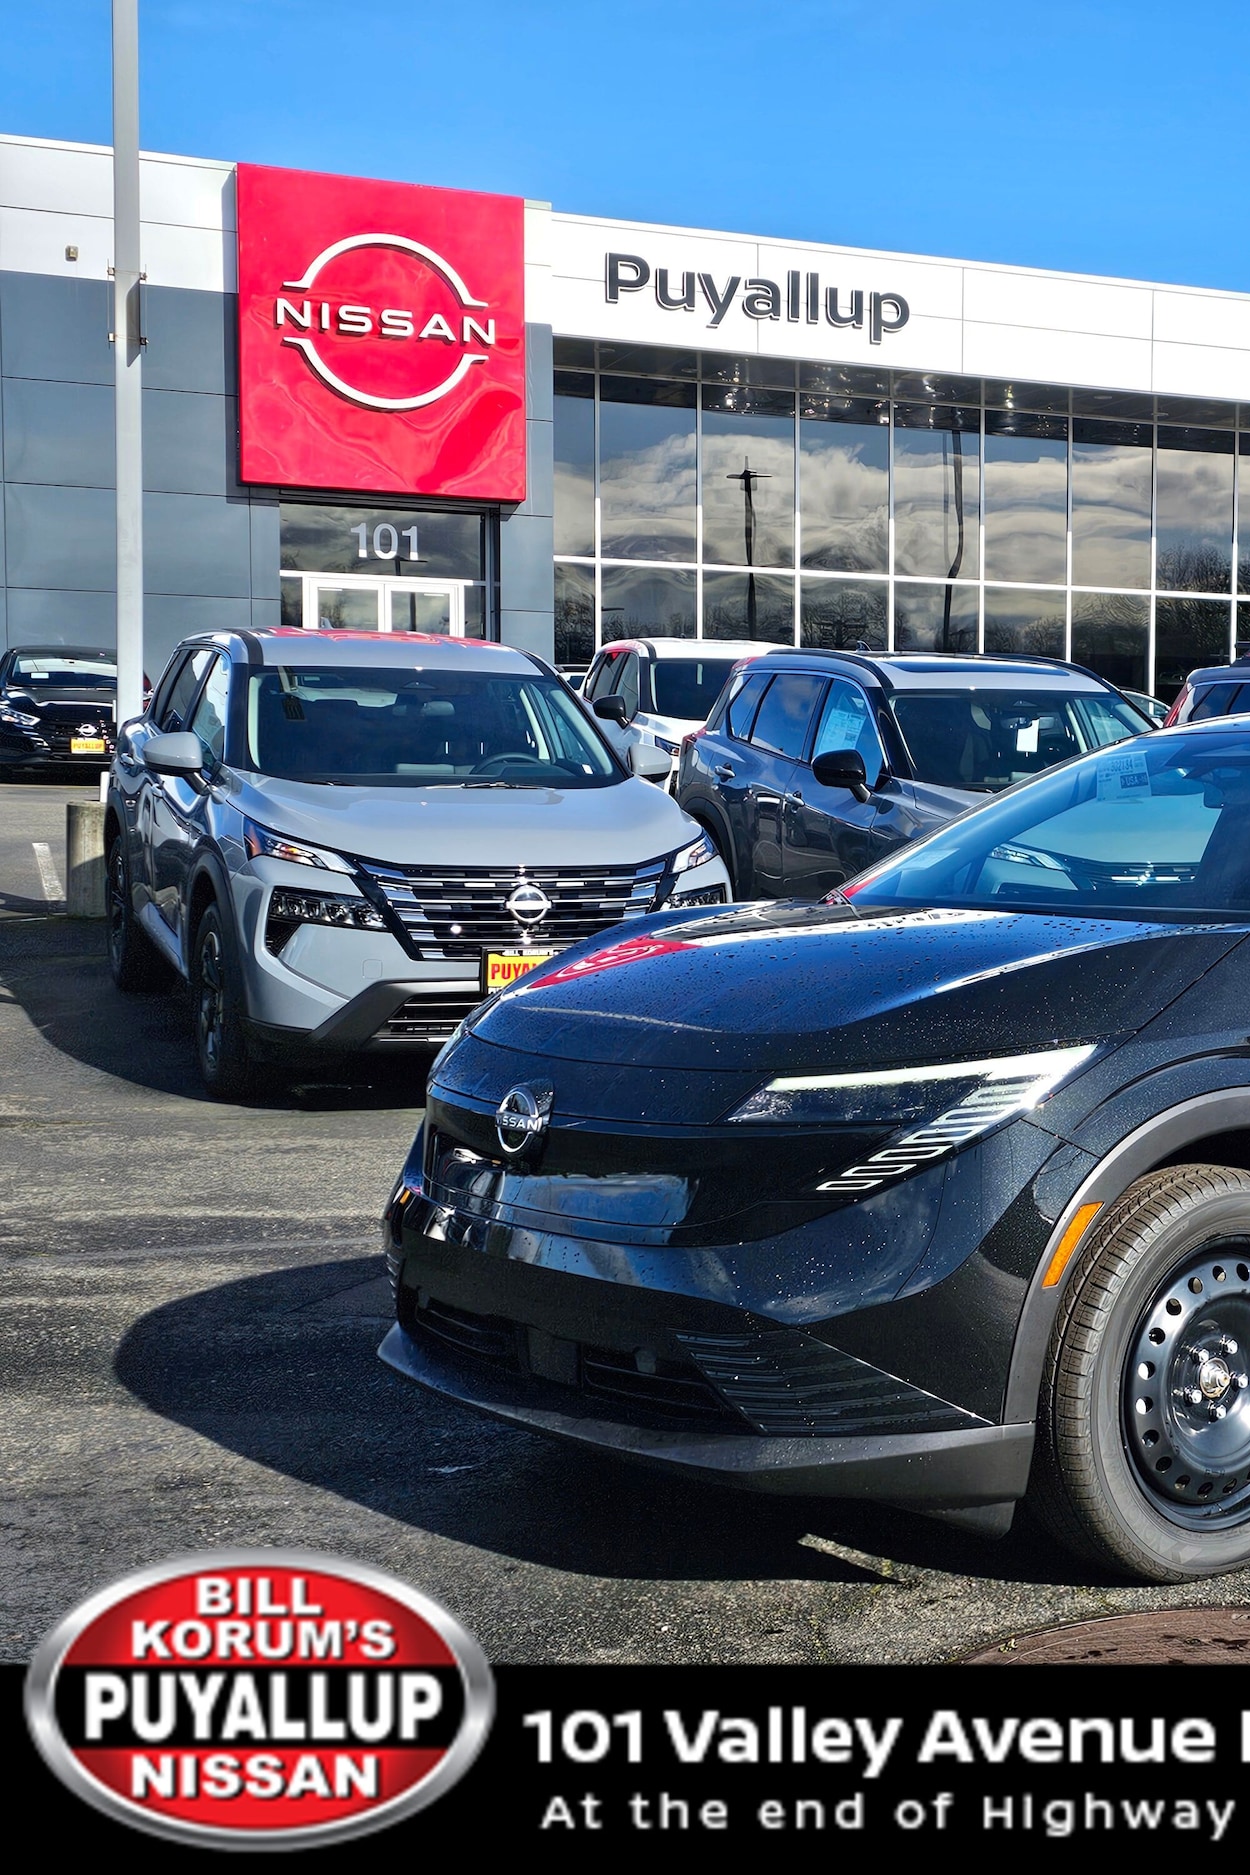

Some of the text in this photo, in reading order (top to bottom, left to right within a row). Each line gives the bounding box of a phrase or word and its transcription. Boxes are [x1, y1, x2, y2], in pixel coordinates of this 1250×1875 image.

[605, 252, 911, 345] Puyallup
[274, 298, 496, 345] NISSAN
[350, 523, 420, 561] 101
[490, 963, 537, 980] PUYA
